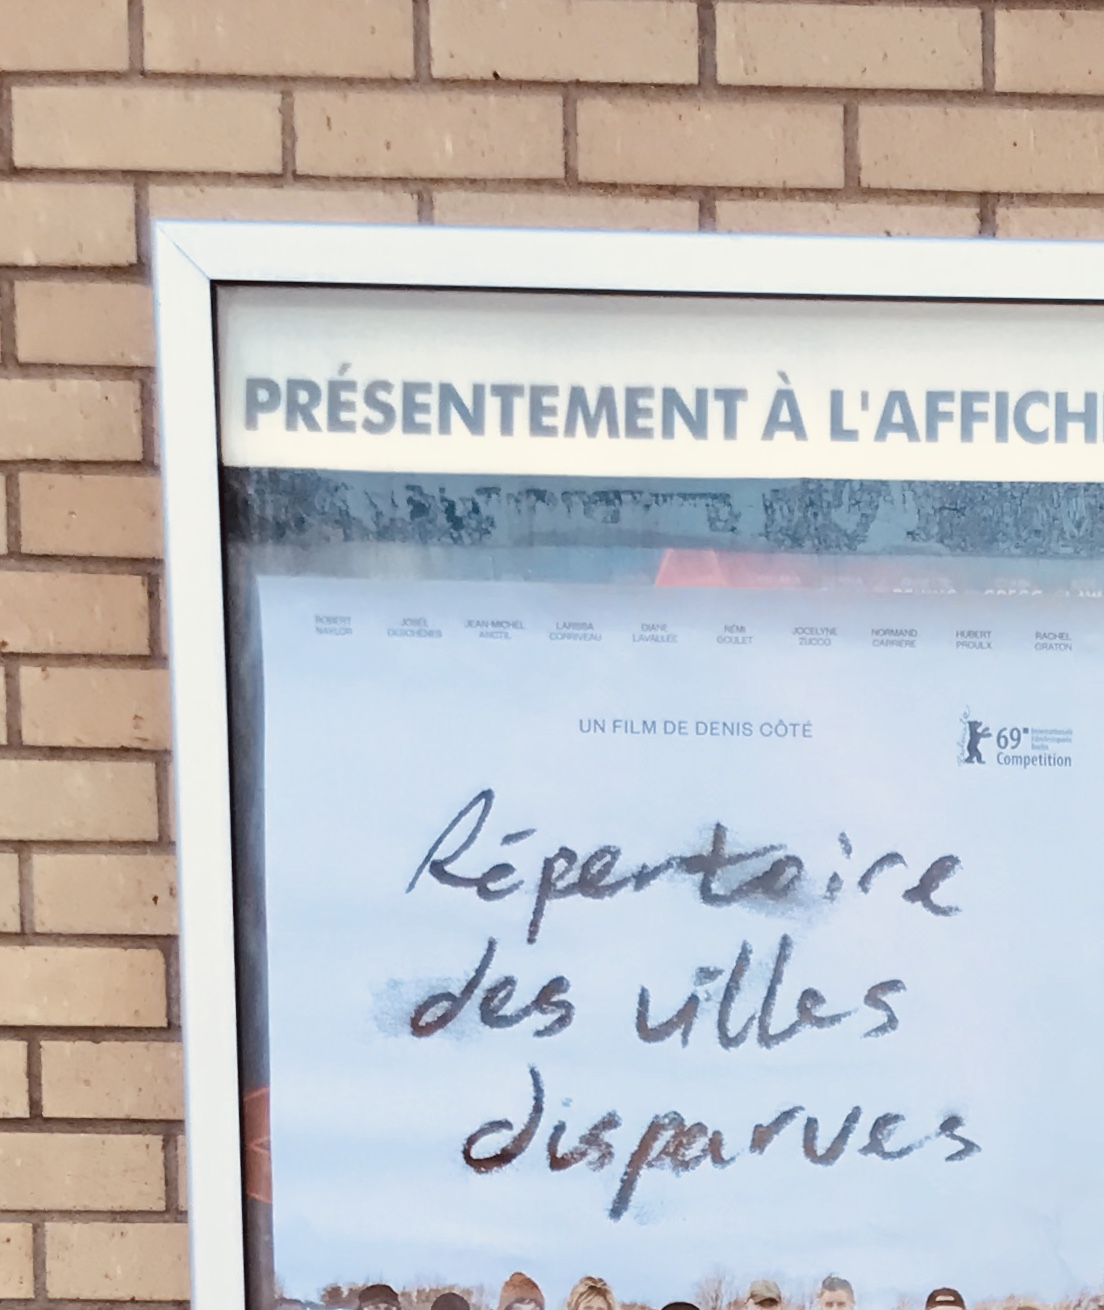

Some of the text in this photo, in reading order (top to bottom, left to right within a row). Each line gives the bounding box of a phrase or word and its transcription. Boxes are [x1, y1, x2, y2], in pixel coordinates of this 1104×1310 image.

[245, 363, 748, 440] PRÉSENTEMENT
[761, 370, 808, 441] À
[641, 623, 668, 632] DIANE
[724, 623, 746, 633] RÉMI
[793, 627, 838, 636] JOCELYNE
[871, 628, 918, 637] NORMAND
[549, 632, 602, 642] CORRIVEAU
[956, 630, 992, 639] HUBERT
[1035, 632, 1071, 641] RACHEL
[716, 635, 753, 645] GOULET
[956, 640, 992, 650] PROULX
[579, 719, 813, 738] UN FILM DE DENIS CÔTÉ
[997, 727, 1022, 750] 69
[996, 752, 1072, 769] Competition
[405, 787, 963, 943] Répertoire
[409, 933, 908, 1050] des villes
[462, 1064, 983, 1221] disparues
